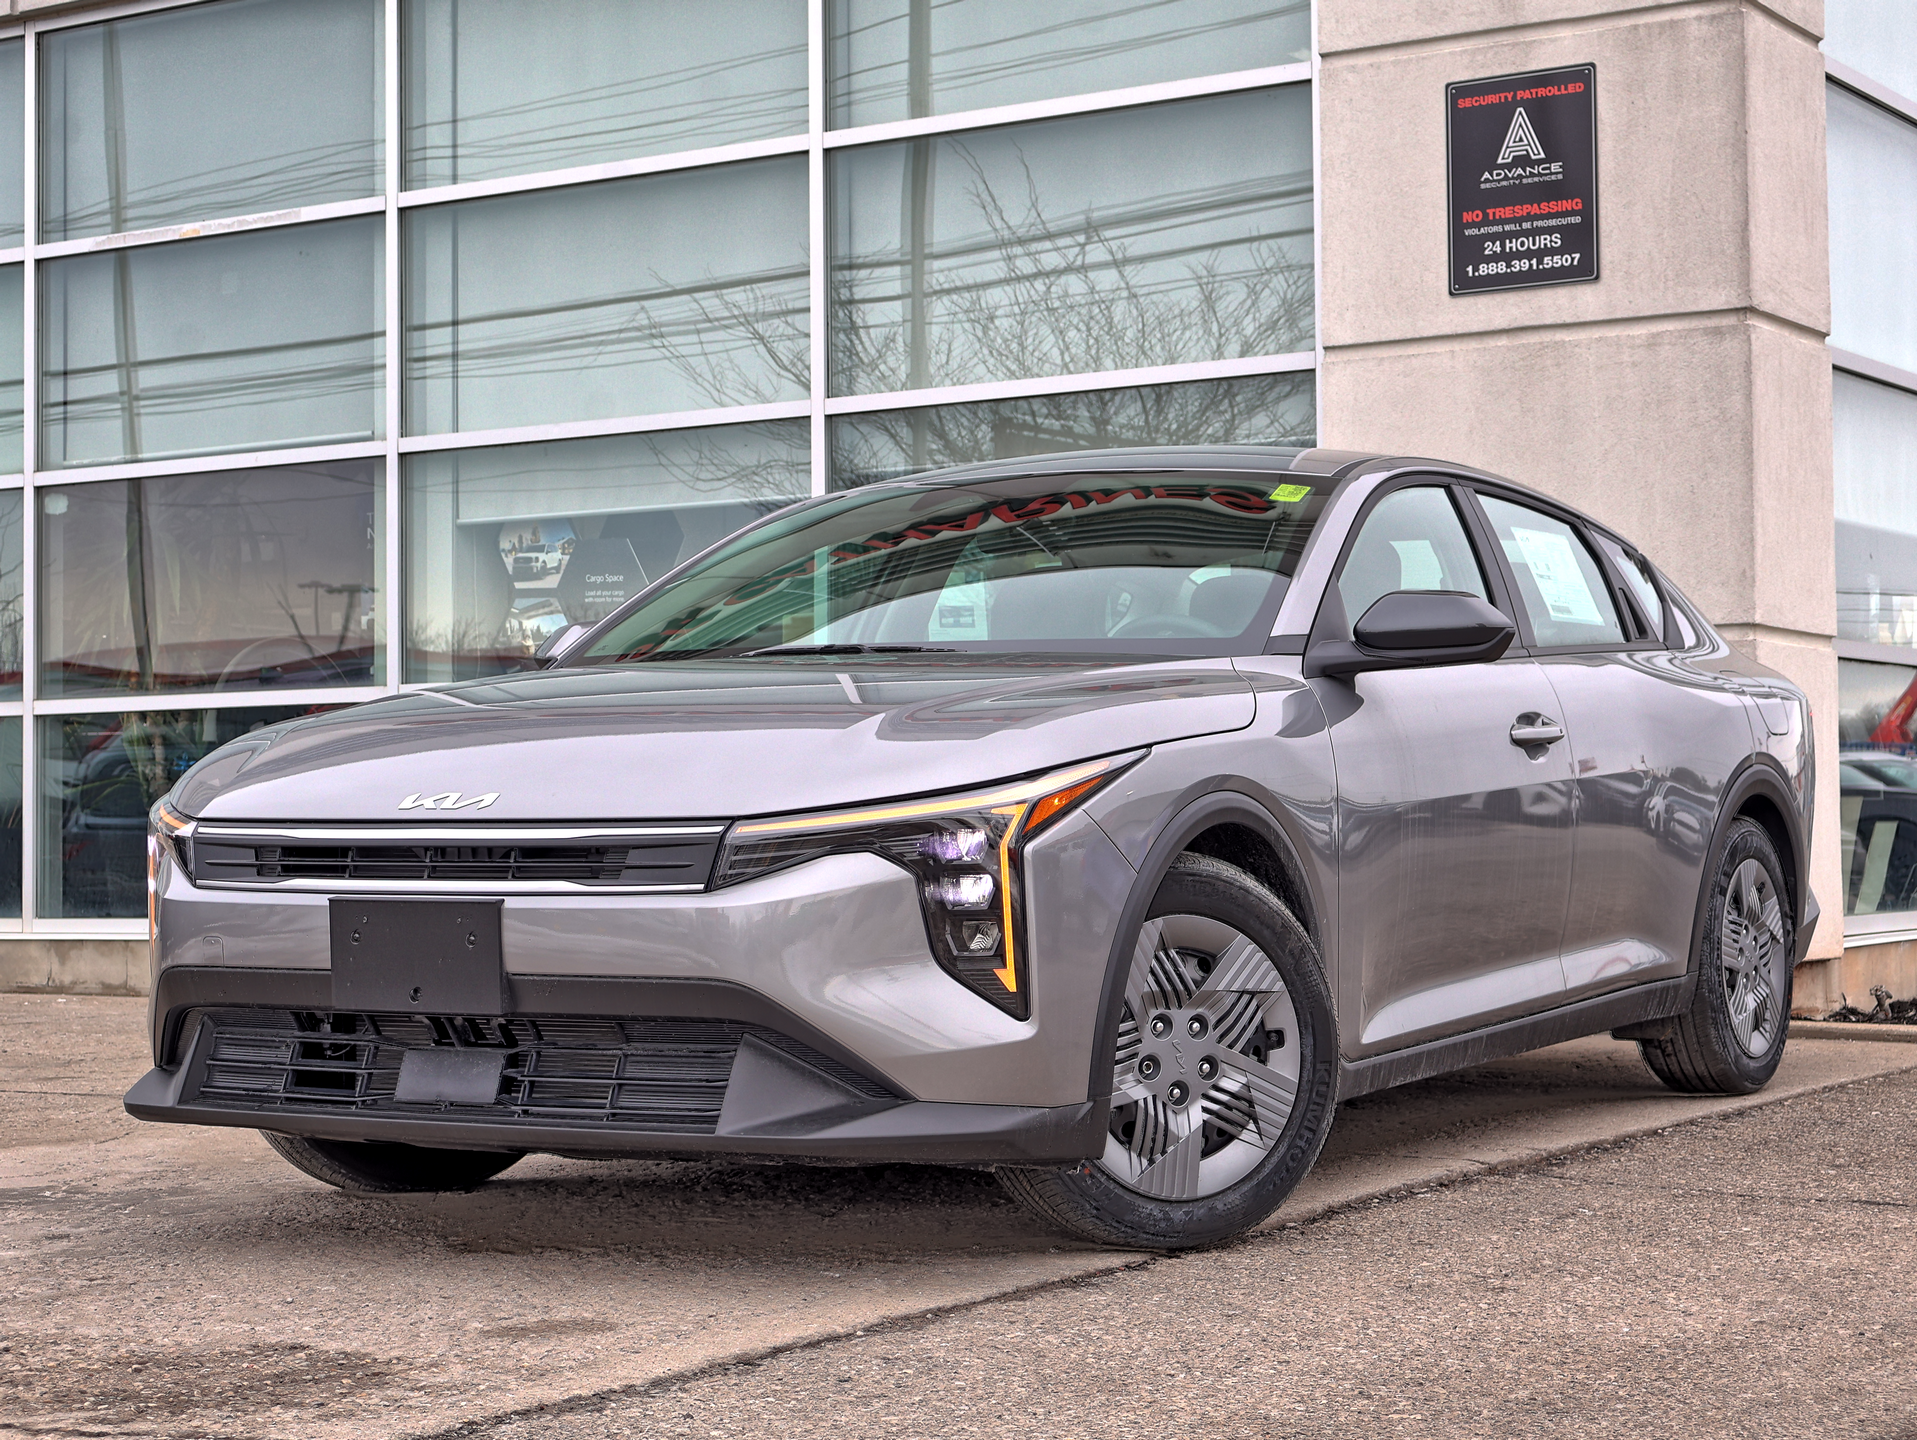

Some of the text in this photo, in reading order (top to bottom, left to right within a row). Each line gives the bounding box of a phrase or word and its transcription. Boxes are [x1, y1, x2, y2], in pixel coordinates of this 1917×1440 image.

[1457, 82, 1585, 108] SECURITY PATROLLED
[1479, 173, 1564, 190] SECURITY SERVICES
[1480, 161, 1564, 182] ADVANCE
[1462, 198, 1583, 223] NO TRESPASSING
[1464, 216, 1582, 236] VIOLATORS WILL BE PROSECUTED
[1483, 233, 1562, 255] 24 HOURS
[1465, 253, 1581, 277] 1.888.391.5507
[585, 573, 624, 584] Cargo Space
[397, 792, 501, 810] KIA
[1286, 1060, 1331, 1168] KUMHO
